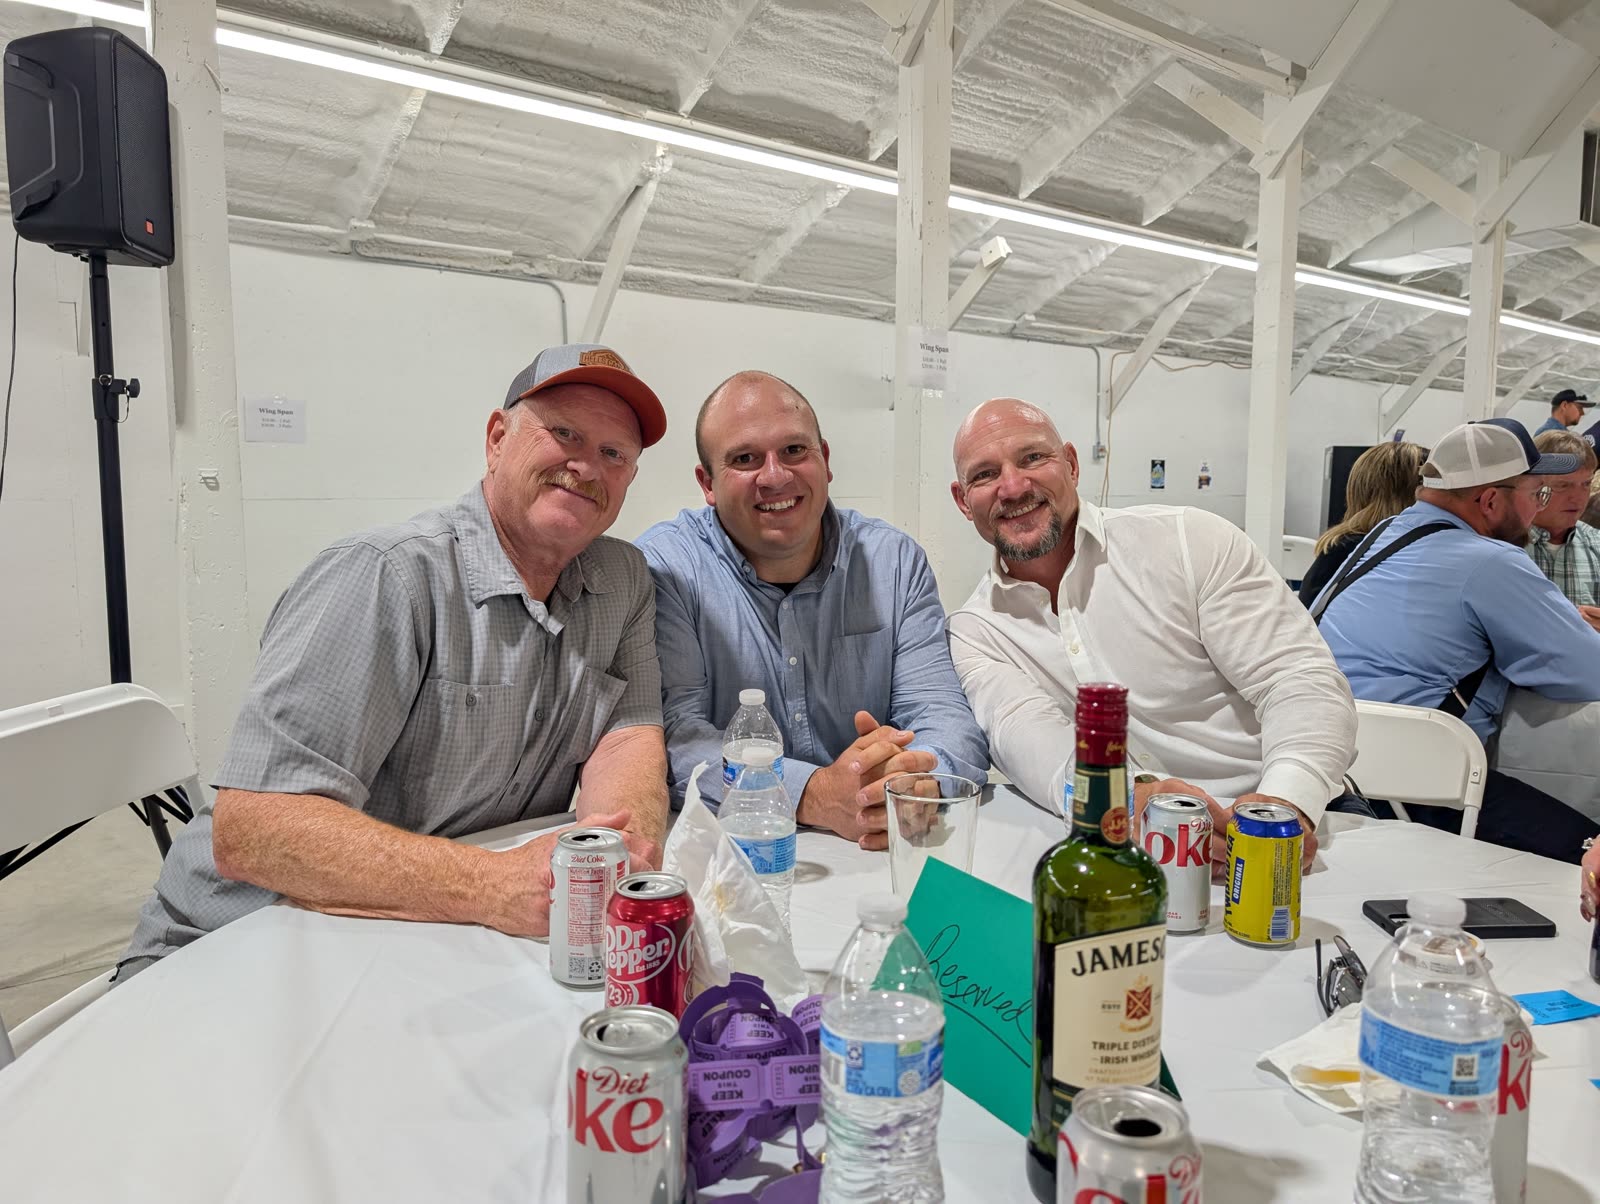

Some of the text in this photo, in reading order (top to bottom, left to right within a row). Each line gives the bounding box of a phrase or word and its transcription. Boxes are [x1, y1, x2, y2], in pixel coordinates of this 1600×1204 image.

[920, 343, 949, 354] Wing Span
[571, 854, 586, 863] Diet
[1233, 862, 1243, 900] ORIGINAL
[570, 885, 590, 893] Calories
[615, 925, 647, 951] Dr
[608, 984, 622, 1005] 23
[795, 1000, 820, 1016] OUPON
[741, 1014, 775, 1024] OUPON
[747, 1030, 774, 1039] KEEP
[1092, 1041, 1130, 1051] TRIPLE
[1100, 1055, 1128, 1065] IRISH
[703, 1069, 751, 1081] COUPON
[789, 1064, 820, 1075] UPON
[592, 1065, 649, 1095] Diet
[718, 1081, 738, 1089] THIS
[711, 1089, 744, 1100] KEEP
[798, 1084, 820, 1095] EEP
[575, 1068, 664, 1153] ke
